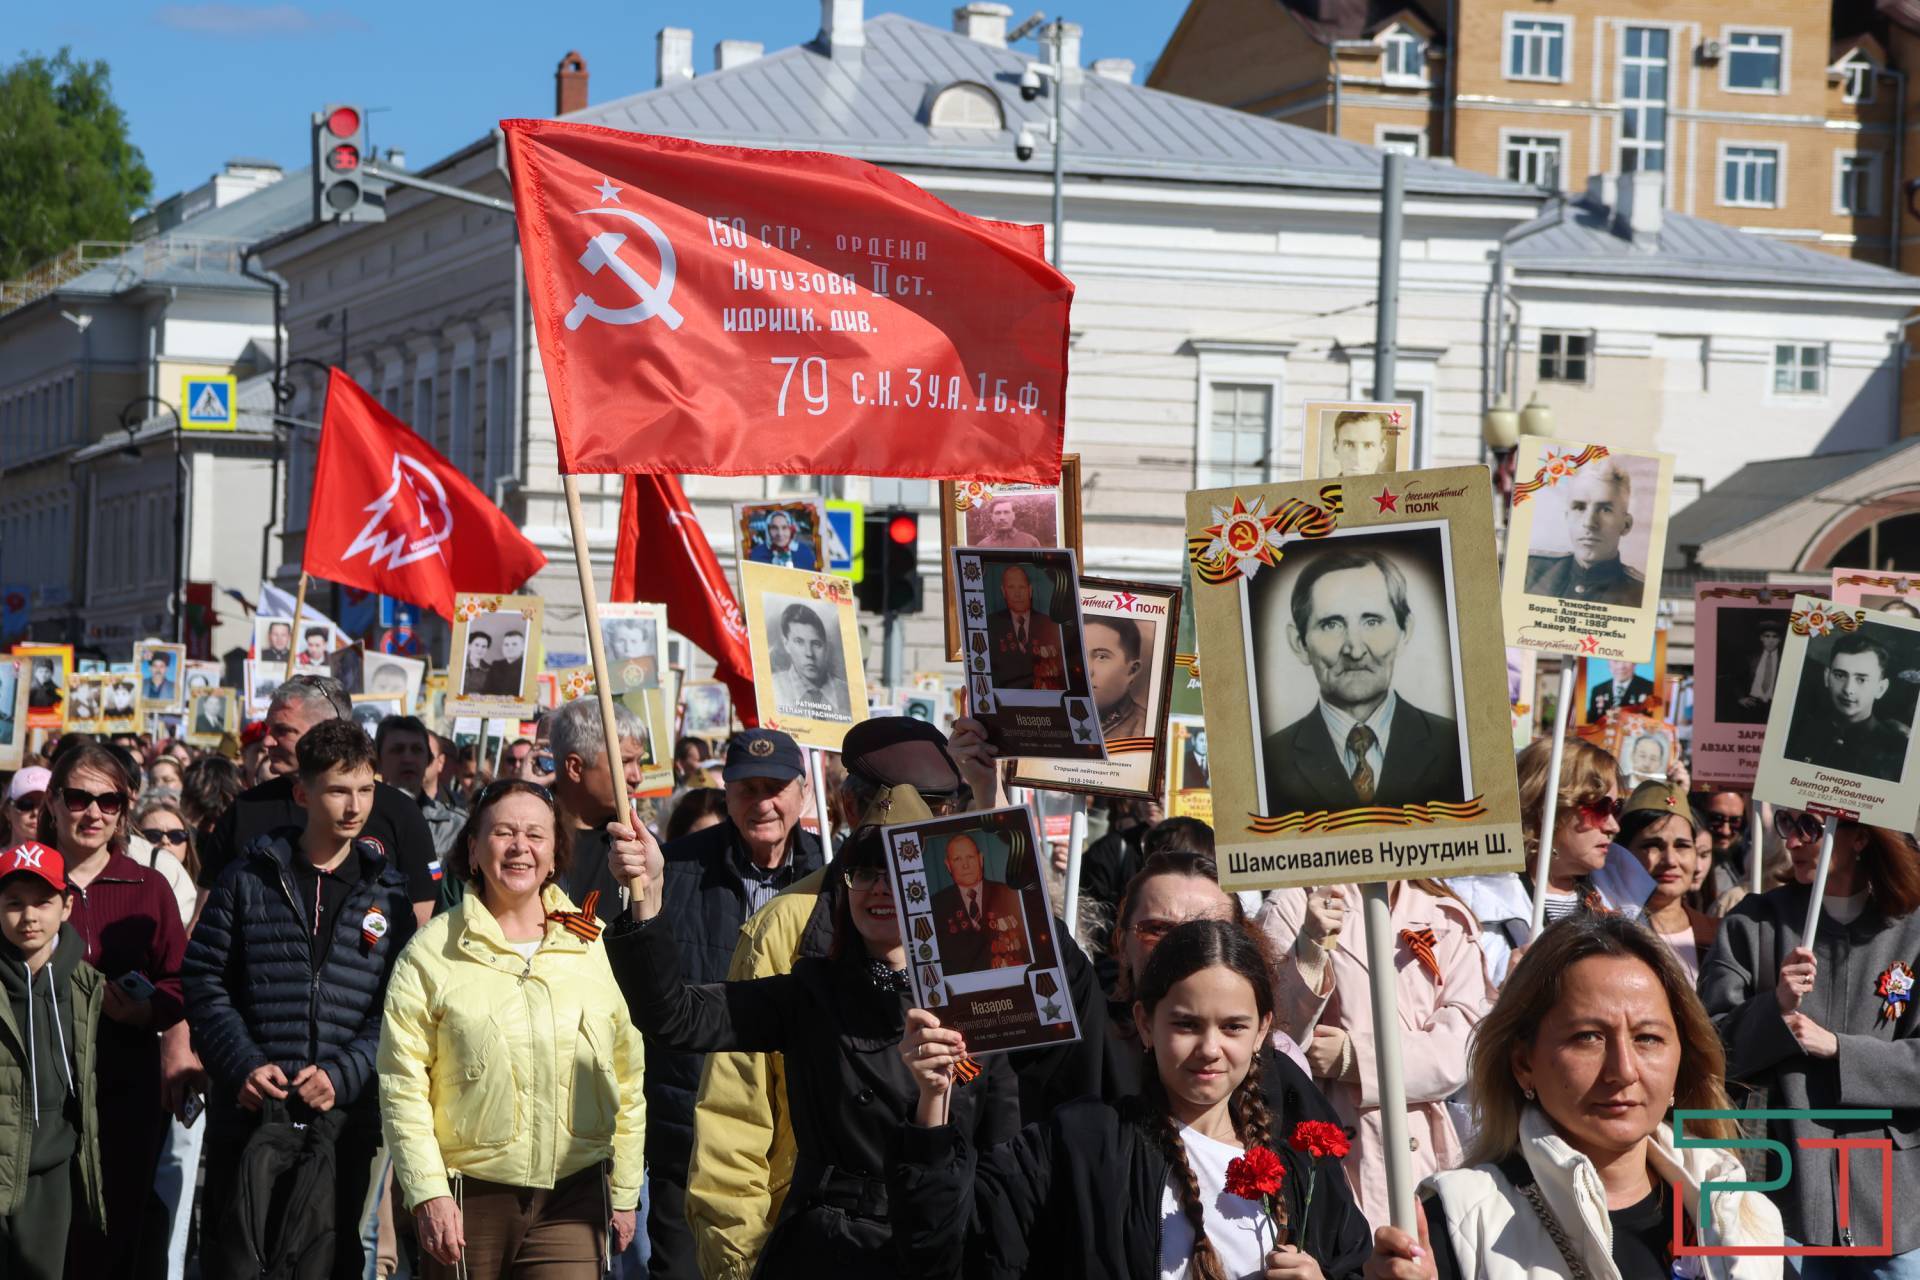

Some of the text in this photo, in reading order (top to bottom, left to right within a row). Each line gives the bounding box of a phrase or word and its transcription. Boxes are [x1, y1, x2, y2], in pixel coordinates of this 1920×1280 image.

[707, 217, 927, 262] 150 СТР. ОРДЕНА
[895, 274, 933, 296] СТ.
[723, 307, 878, 334] ИДРИЦК. ДИВ.
[770, 356, 829, 417] 79
[1405, 502, 1440, 514] ПОЛК
[1136, 603, 1166, 615] ПОЛК
[1528, 603, 1636, 625] Борис Александрович
[1558, 599, 1608, 613] Тимофеев
[1553, 615, 1576, 625] 1909
[1534, 620, 1626, 639] Майор Медслужбы
[1187, 678, 1201, 689] Дм
[795, 699, 832, 712] РАТНИКОВ
[1015, 712, 1052, 728] Назаров
[1737, 744, 1761, 754] ИСМ
[1738, 758, 1760, 769] Ряд
[1815, 771, 1862, 789] Гончаров
[1790, 776, 1885, 805] Виктор Яковлевич
[13, 844, 45, 868] NY
[1228, 832, 1512, 874] Шамсивалиев Нурутдин Ш.
[971, 999, 1014, 1016] Назаров
